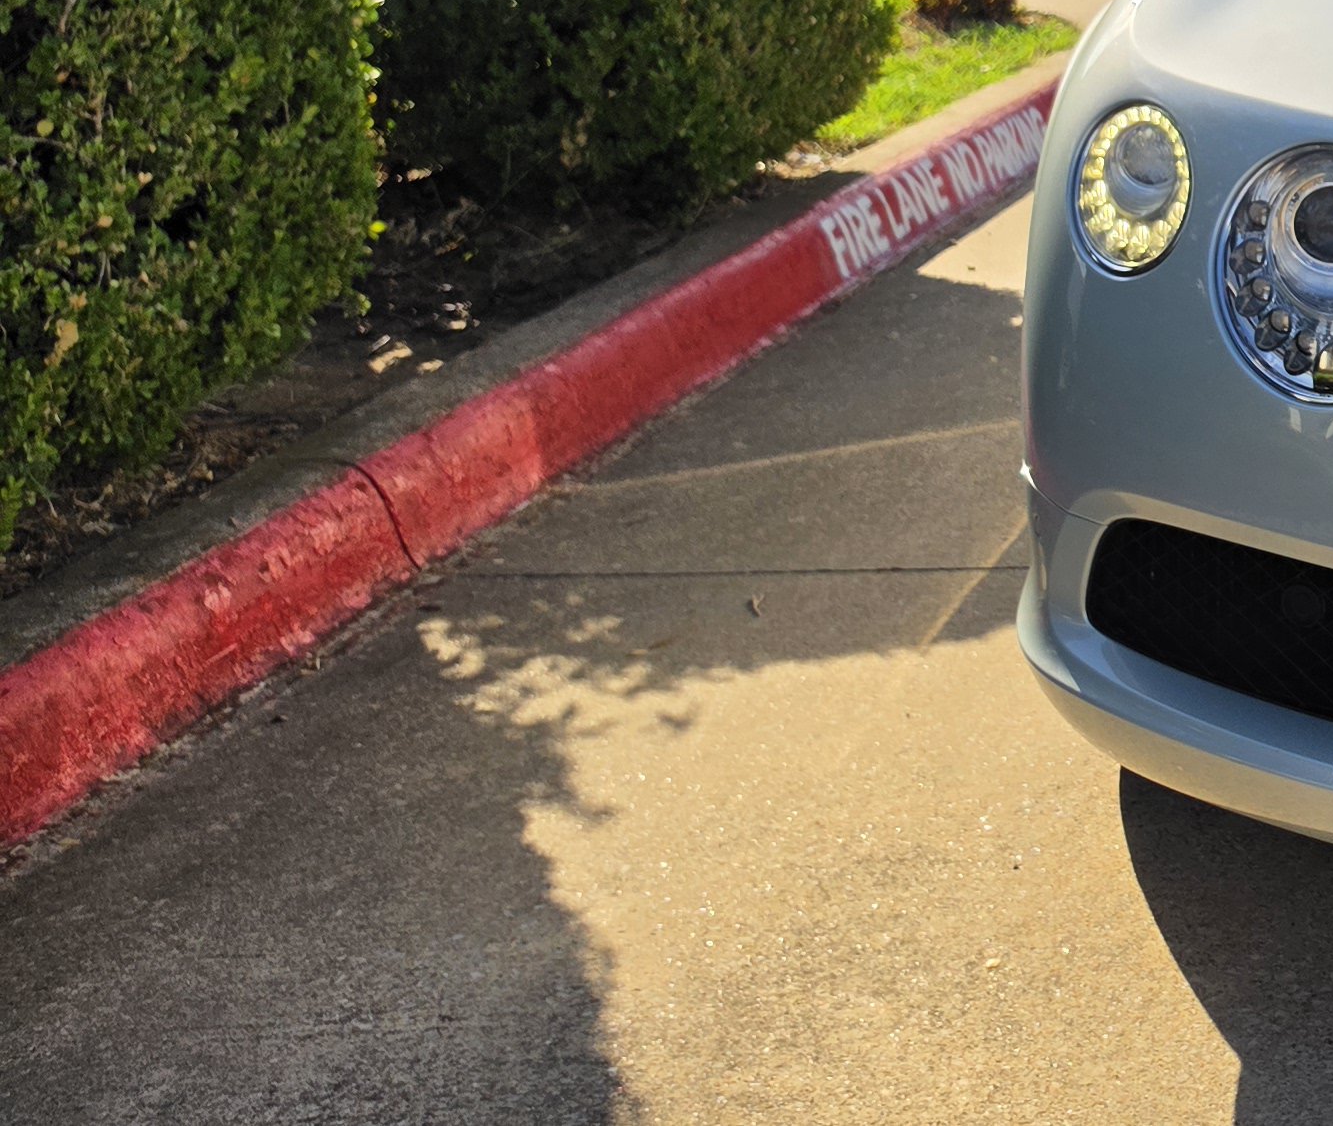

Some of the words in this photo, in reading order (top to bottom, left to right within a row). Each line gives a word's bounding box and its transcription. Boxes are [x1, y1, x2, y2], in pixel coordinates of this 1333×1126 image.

[820, 195, 890, 279] FIRE
[875, 158, 950, 240] LANE
[940, 142, 987, 204] NO
